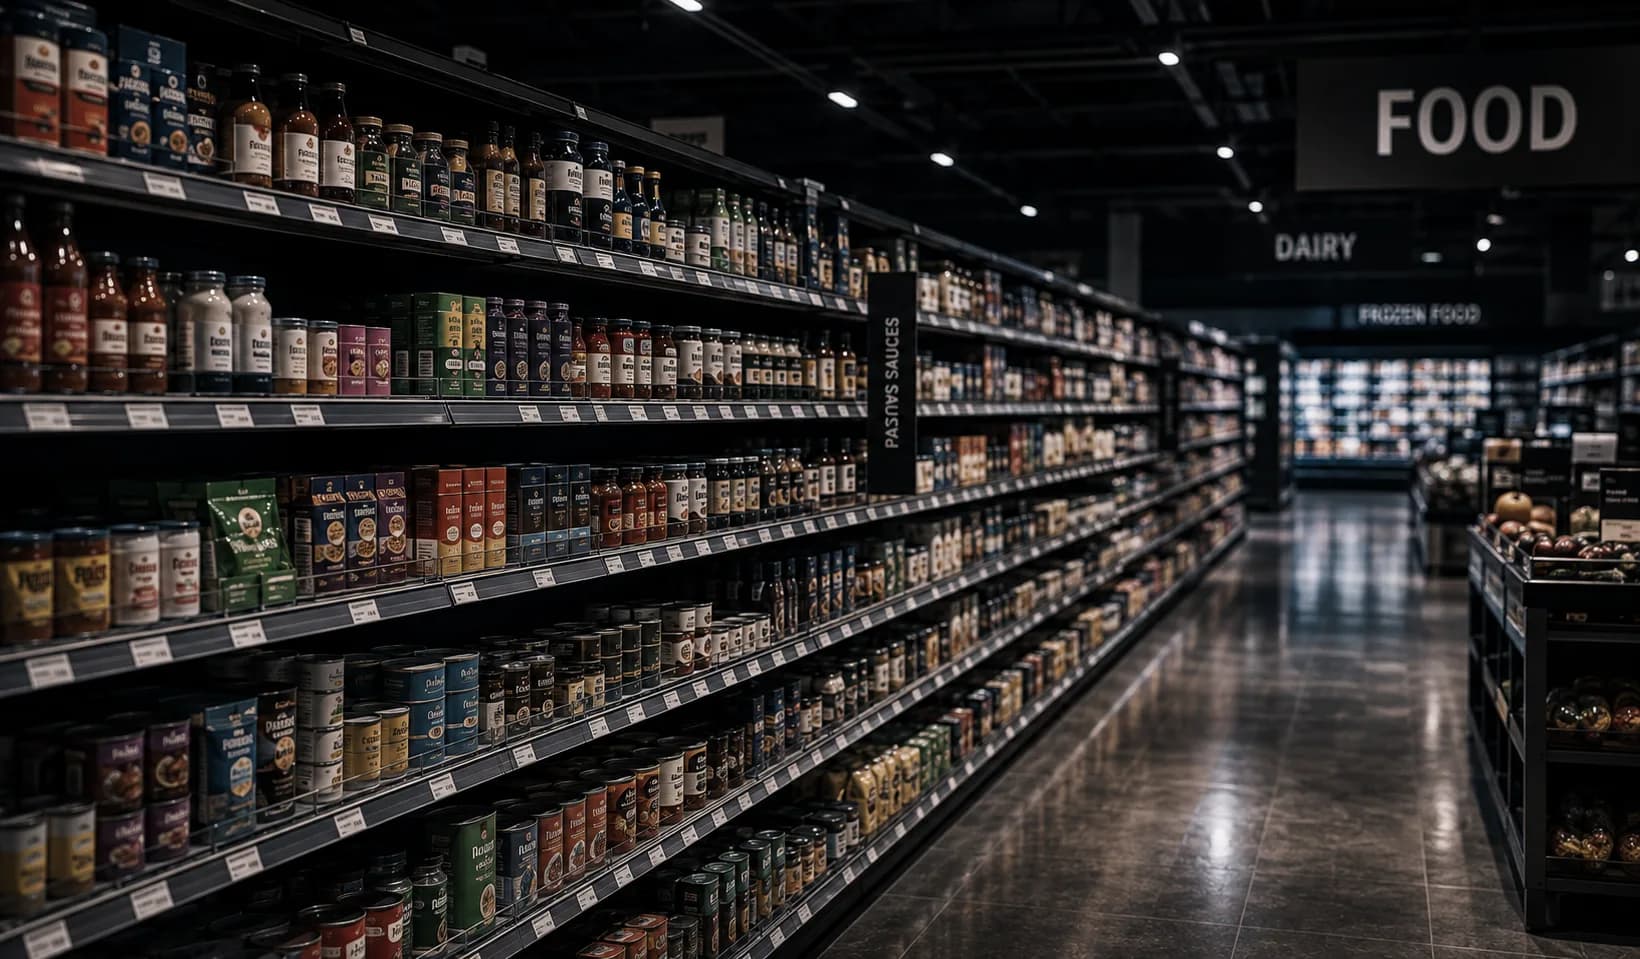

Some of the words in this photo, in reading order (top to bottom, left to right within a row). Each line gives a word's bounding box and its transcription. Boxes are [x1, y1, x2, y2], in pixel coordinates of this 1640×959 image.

[1376, 84, 1579, 157] FOOD
[1274, 232, 1357, 262] DAIRY
[1357, 303, 1426, 326] FROZEN
[1428, 303, 1482, 326] FOOD
[884, 316, 900, 380] SAUCES
